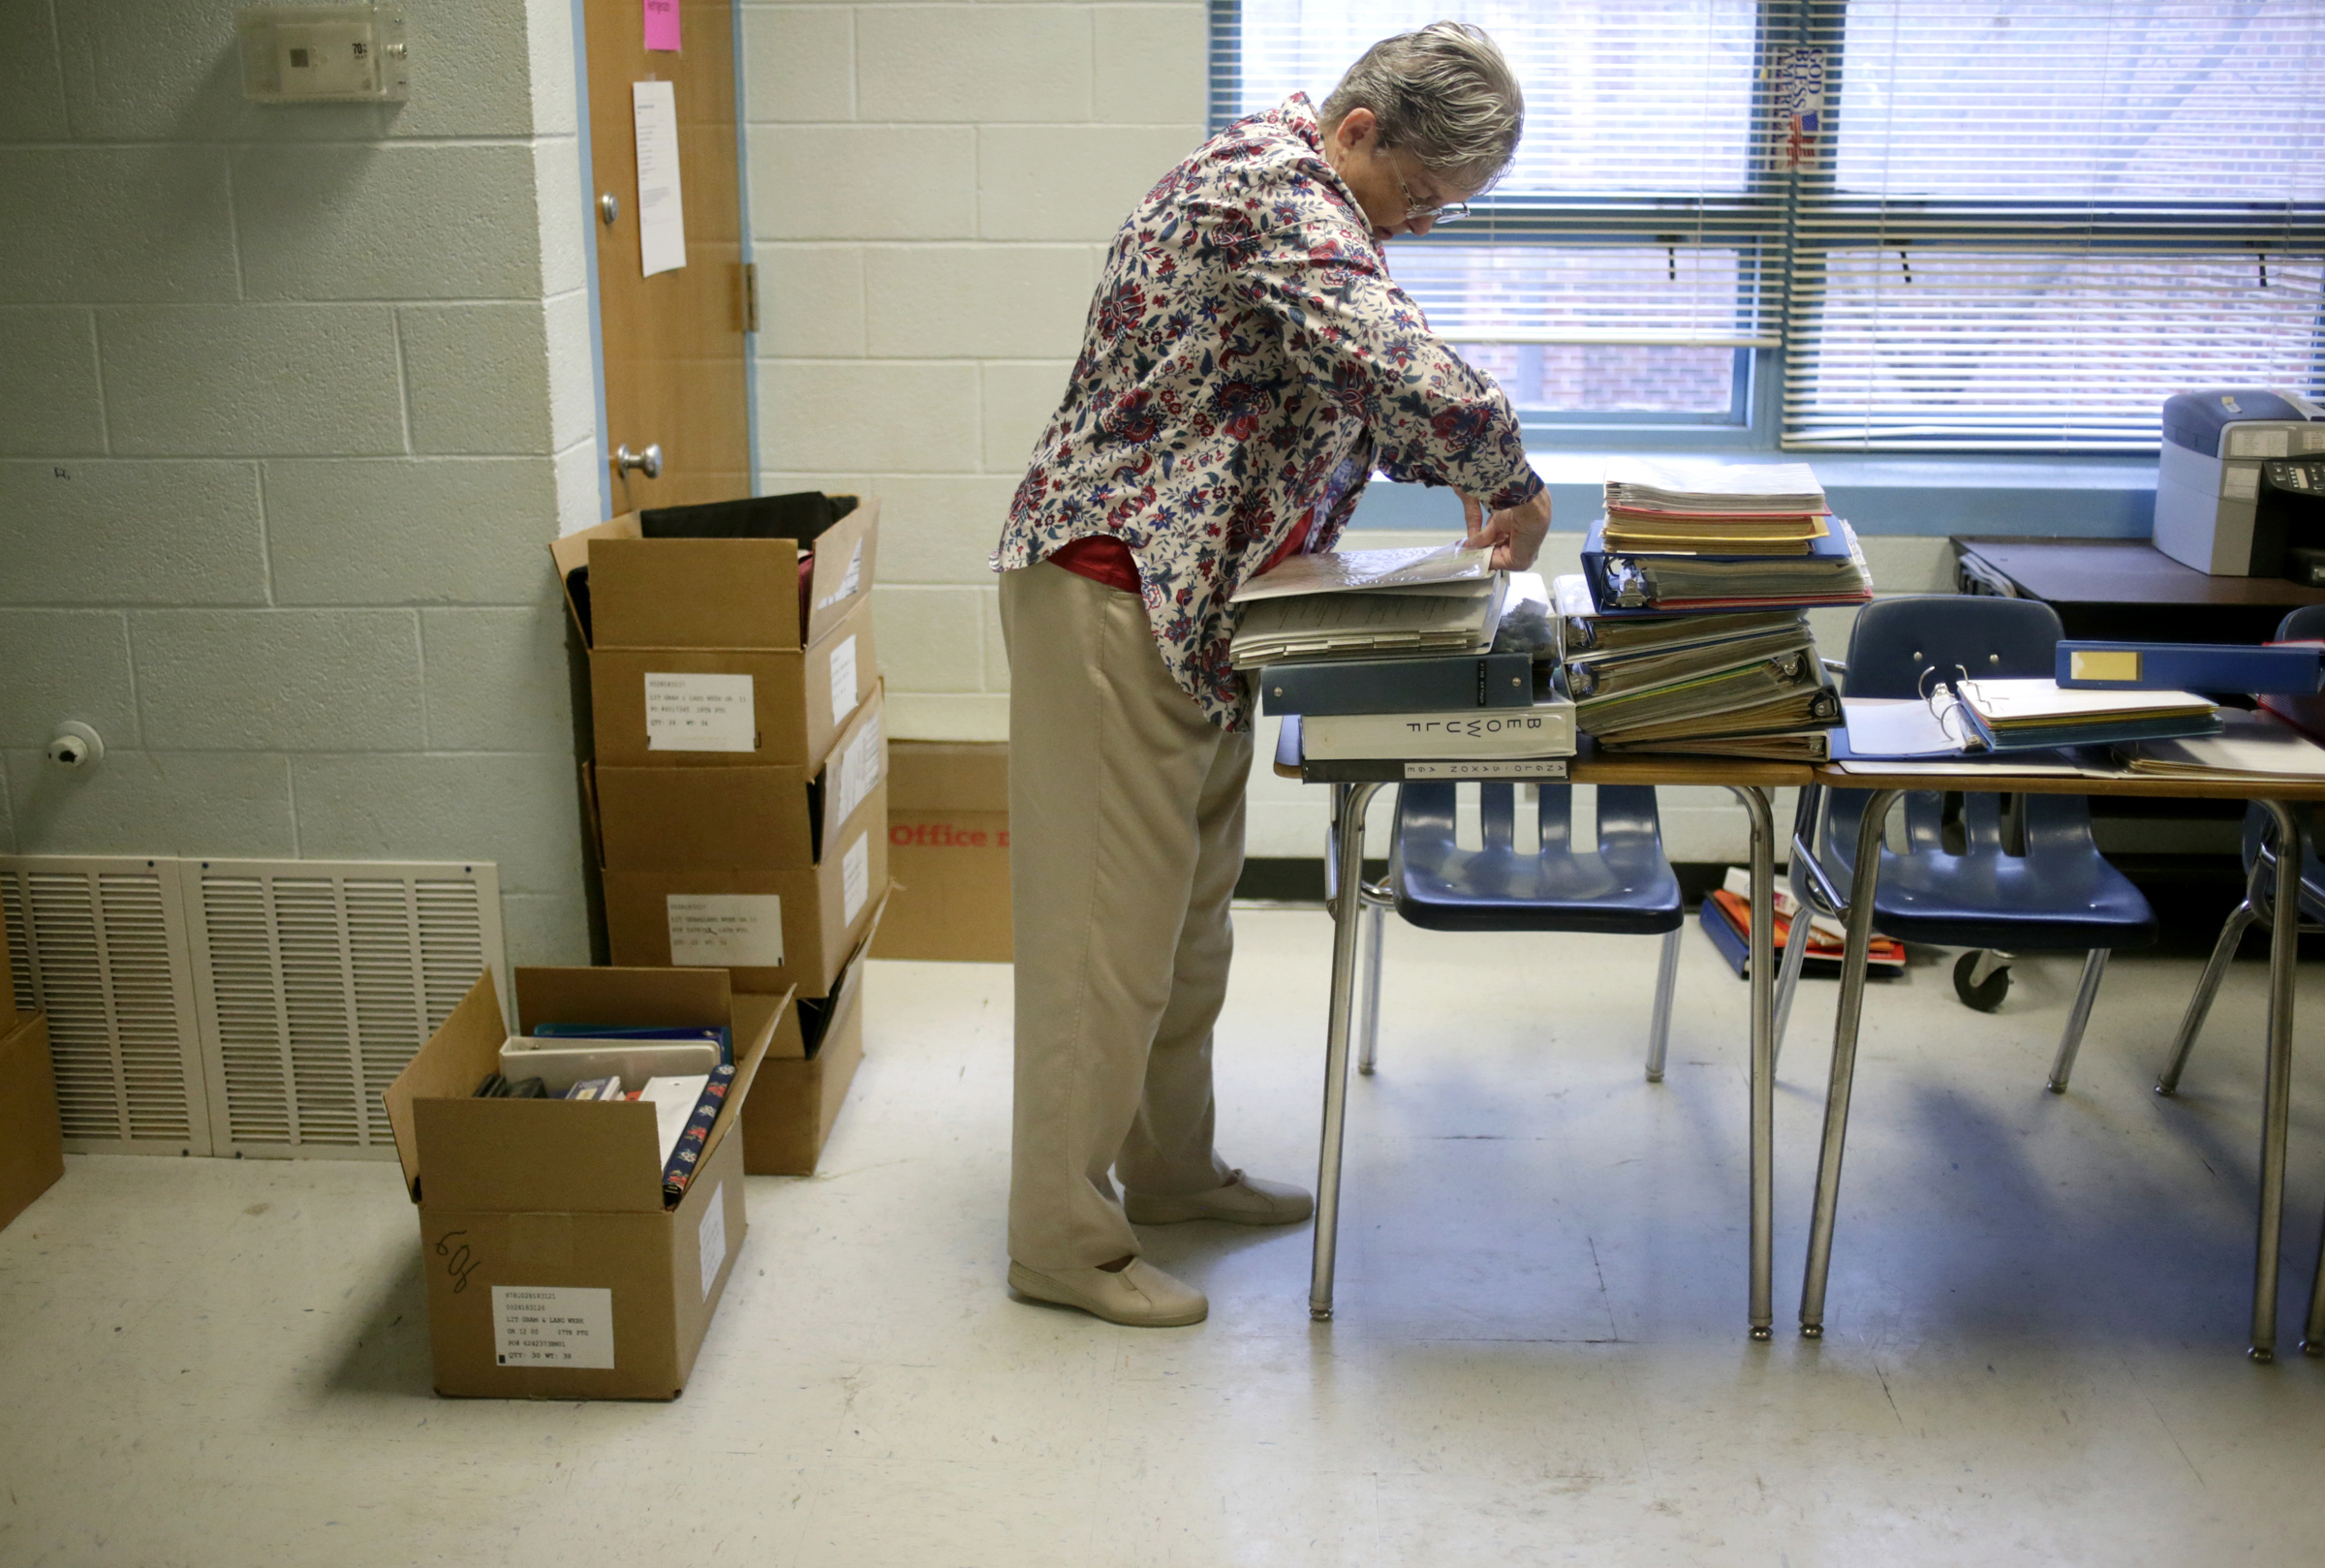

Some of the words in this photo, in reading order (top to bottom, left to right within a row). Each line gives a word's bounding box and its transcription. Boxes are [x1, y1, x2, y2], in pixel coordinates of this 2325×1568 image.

[352, 43, 362, 54] 70
[1792, 49, 1811, 108] BLESS
[1809, 48, 1824, 94] GOD
[1406, 718, 1542, 738] BEOWULF
[1450, 764, 1565, 773] ANGLO-SAXON
[889, 823, 988, 847] Office
